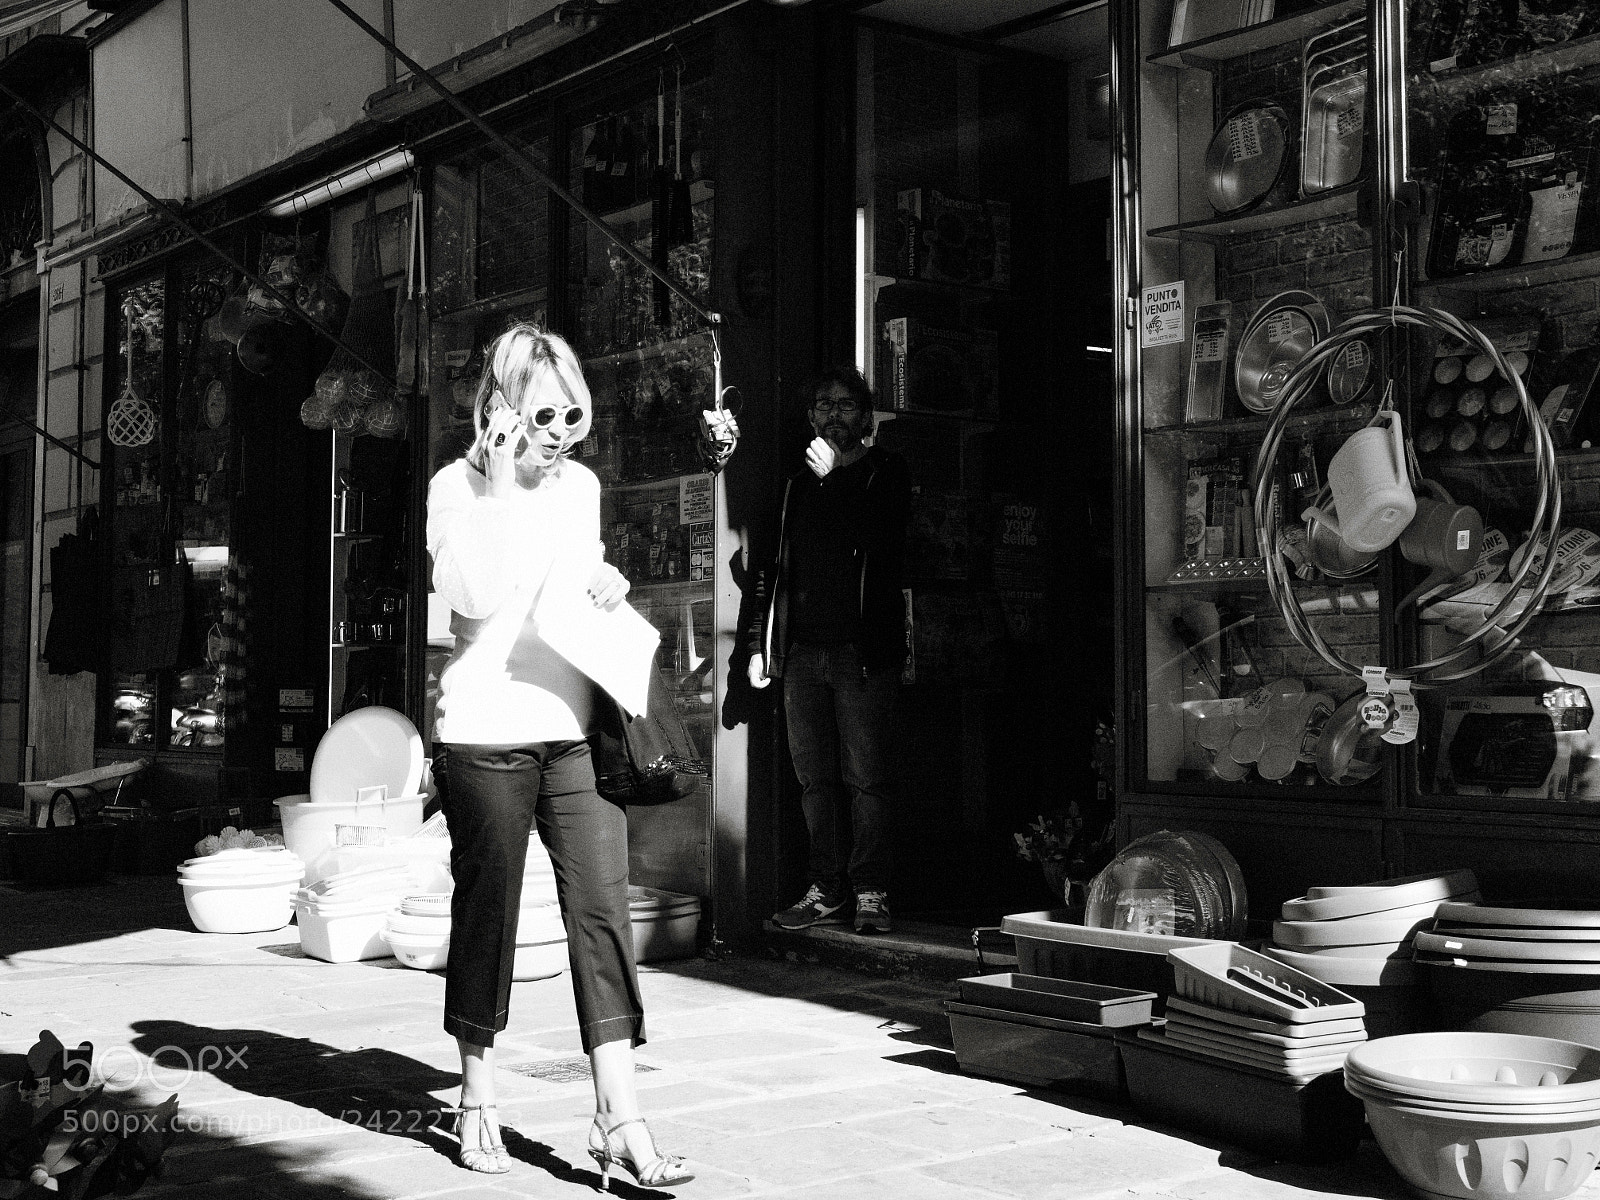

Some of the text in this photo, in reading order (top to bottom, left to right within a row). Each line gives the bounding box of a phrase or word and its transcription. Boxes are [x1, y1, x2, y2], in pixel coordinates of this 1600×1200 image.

[1146, 288, 1179, 304] PUNTO
[1144, 300, 1182, 316] VENDITA
[1003, 502, 1037, 523] enjoy
[1005, 518, 1033, 534] your
[1002, 531, 1038, 546] selfie
[1556, 530, 1591, 557] STONE
